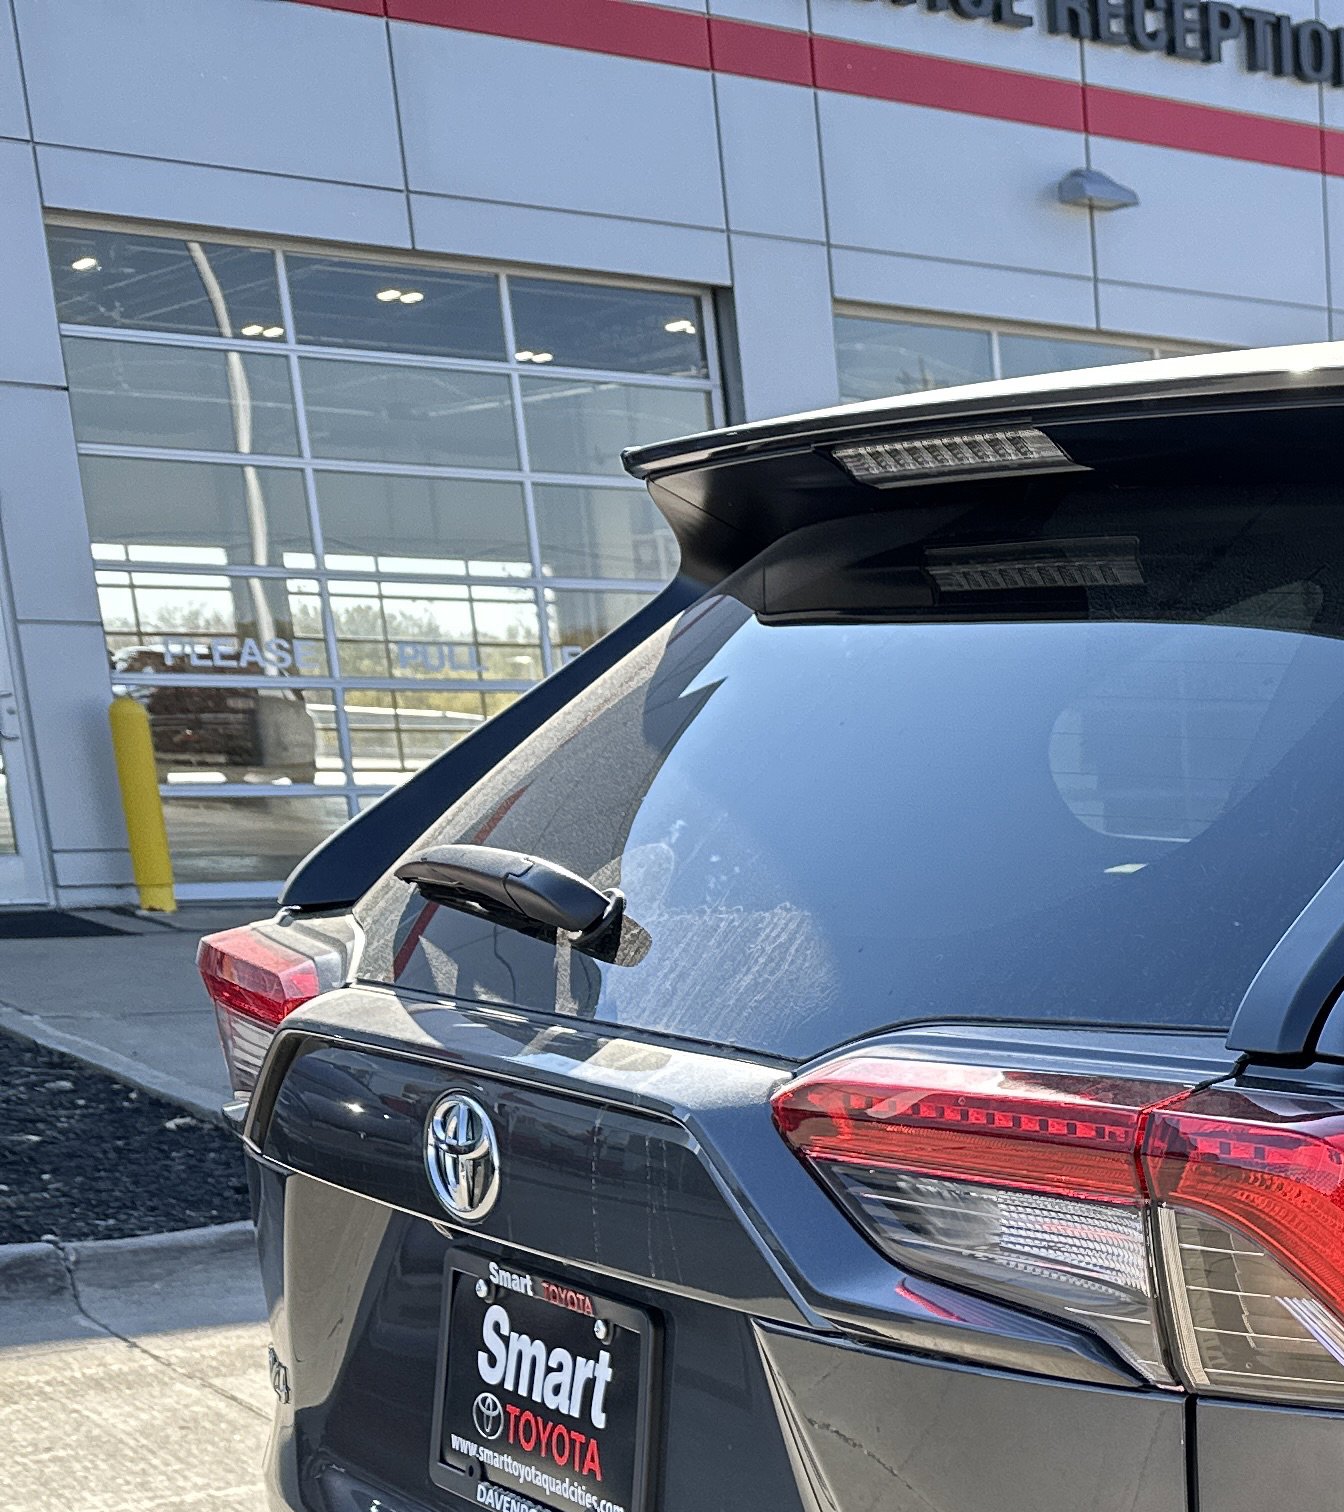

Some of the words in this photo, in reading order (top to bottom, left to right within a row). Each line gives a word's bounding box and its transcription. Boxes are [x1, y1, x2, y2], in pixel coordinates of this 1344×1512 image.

[164, 636, 321, 669] PLEASE
[398, 642, 489, 672] PULL
[488, 1261, 534, 1297] Smart
[541, 1279, 595, 1317] TOYOTA
[477, 1305, 613, 1429] Smart
[505, 1403, 603, 1481] TOYOTA
